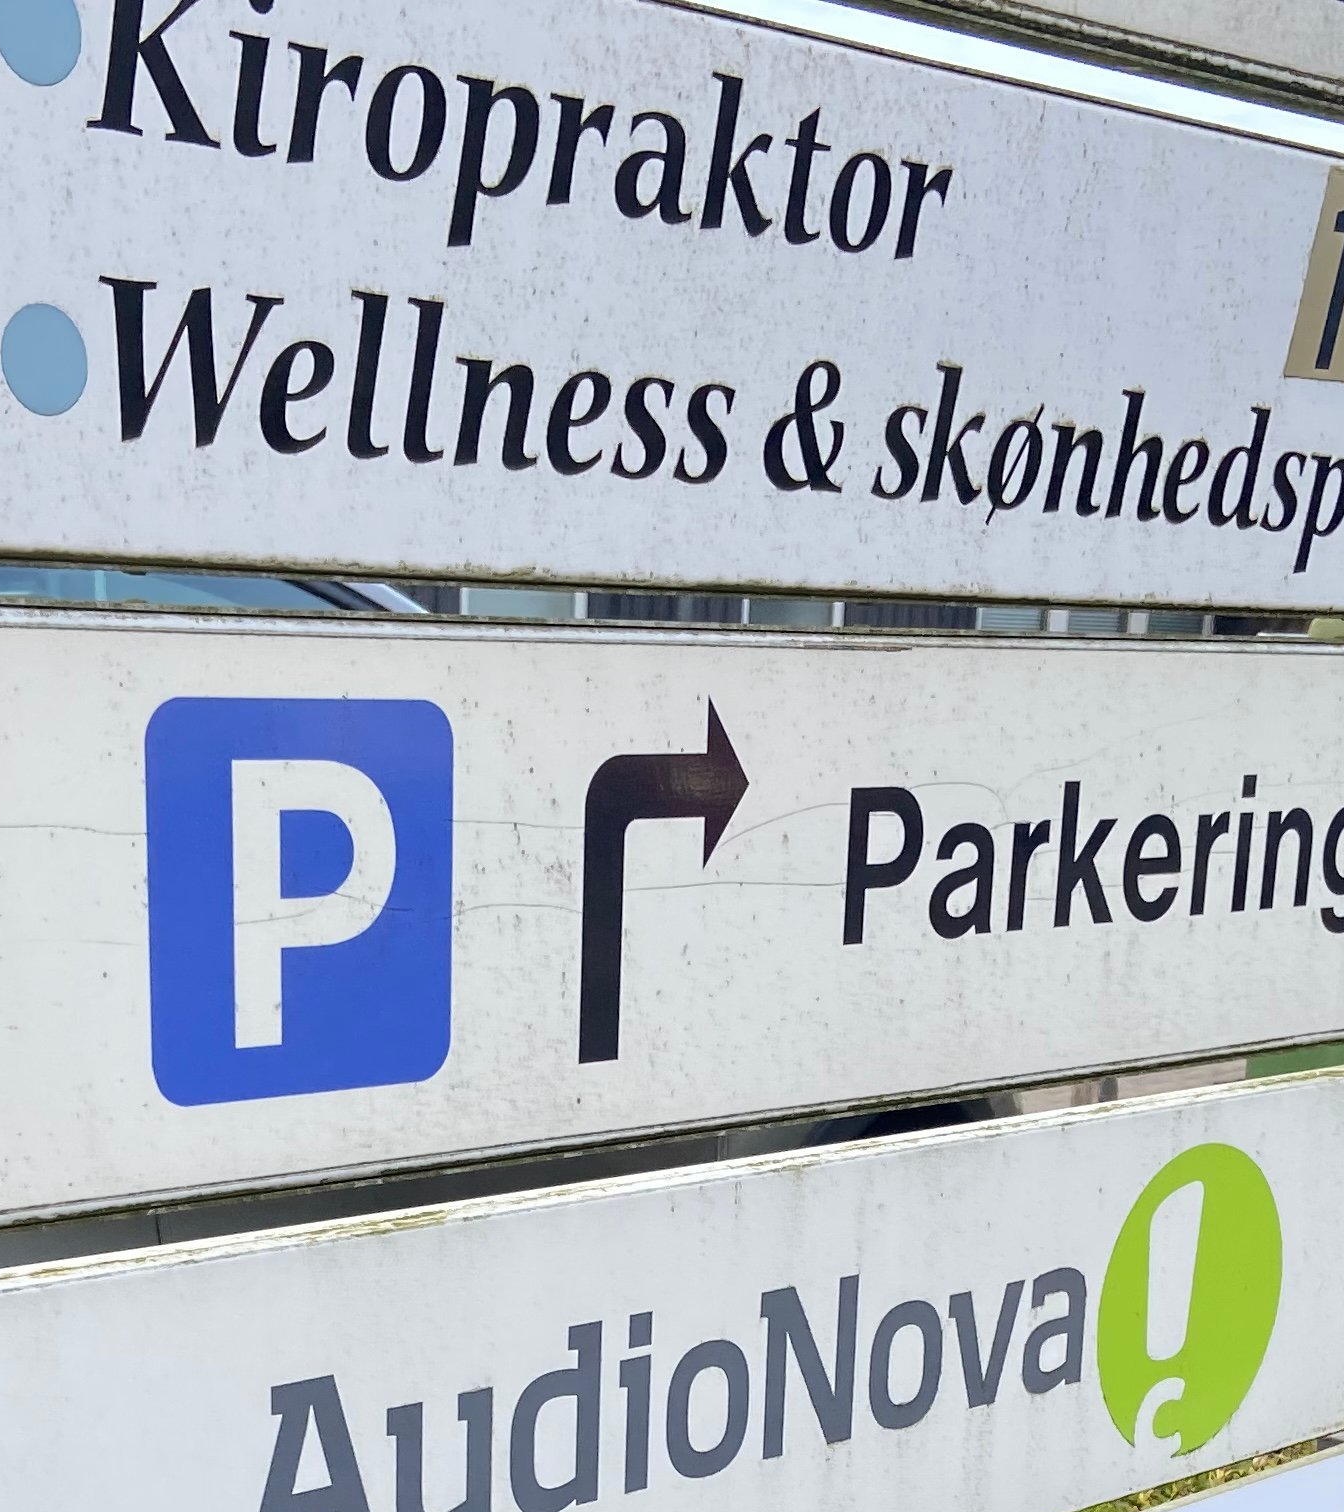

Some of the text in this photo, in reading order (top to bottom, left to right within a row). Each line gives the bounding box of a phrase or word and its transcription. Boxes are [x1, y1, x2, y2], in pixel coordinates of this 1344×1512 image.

[85, 0, 954, 261] Kiropraktor
[97, 274, 737, 485] Wellness
[762, 359, 846, 495] &
[230, 758, 398, 1051] P
